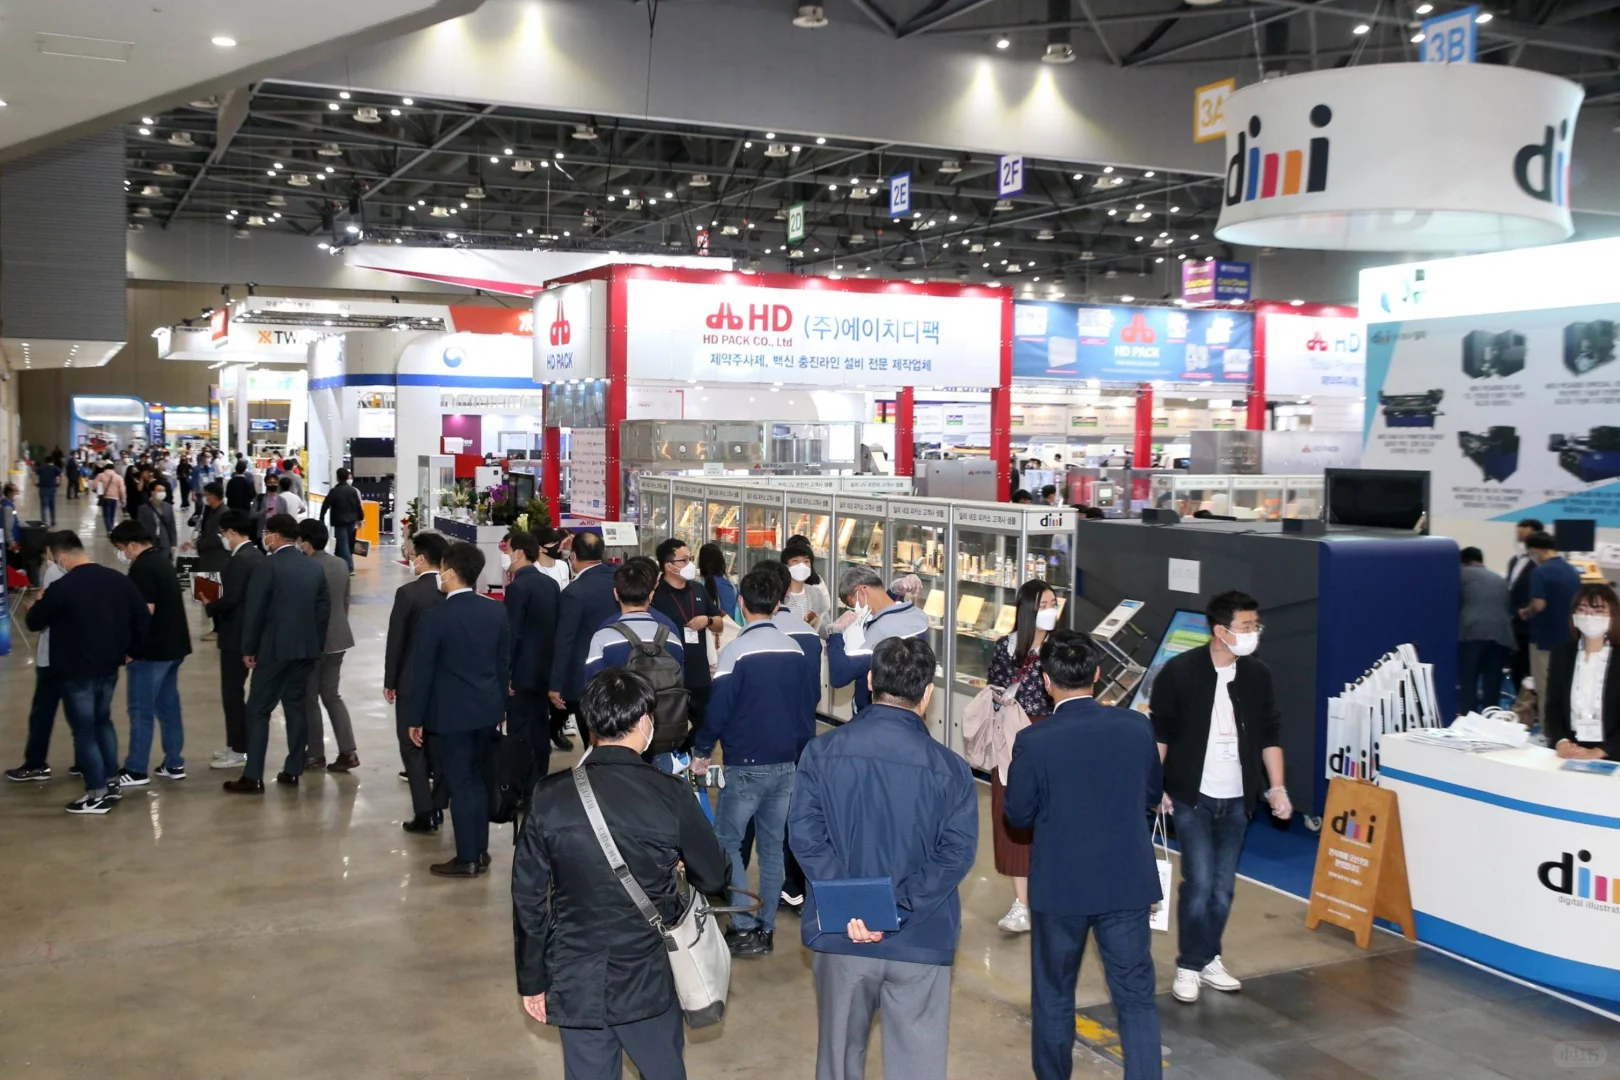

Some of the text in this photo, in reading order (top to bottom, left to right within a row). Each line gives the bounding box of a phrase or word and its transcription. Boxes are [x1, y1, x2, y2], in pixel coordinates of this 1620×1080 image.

[1429, 26, 1466, 62] 3B
[1003, 158, 1020, 187] 2F
[894, 183, 906, 208] 2E
[790, 213, 802, 233] 2D
[749, 304, 793, 332] HD
[703, 334, 718, 345] HD
[721, 335, 750, 346] PACK
[777, 337, 792, 348] Ltd
[804, 315, 940, 345] (주)에이치디팩
[546, 352, 573, 370] HD PACK
[773, 355, 794, 368] 백신
[798, 356, 840, 370] 충진라인
[844, 357, 864, 370] 설비
[868, 358, 888, 371] 전문
[892, 358, 932, 372] 제작업체
[1558, 896, 1584, 908] digital
